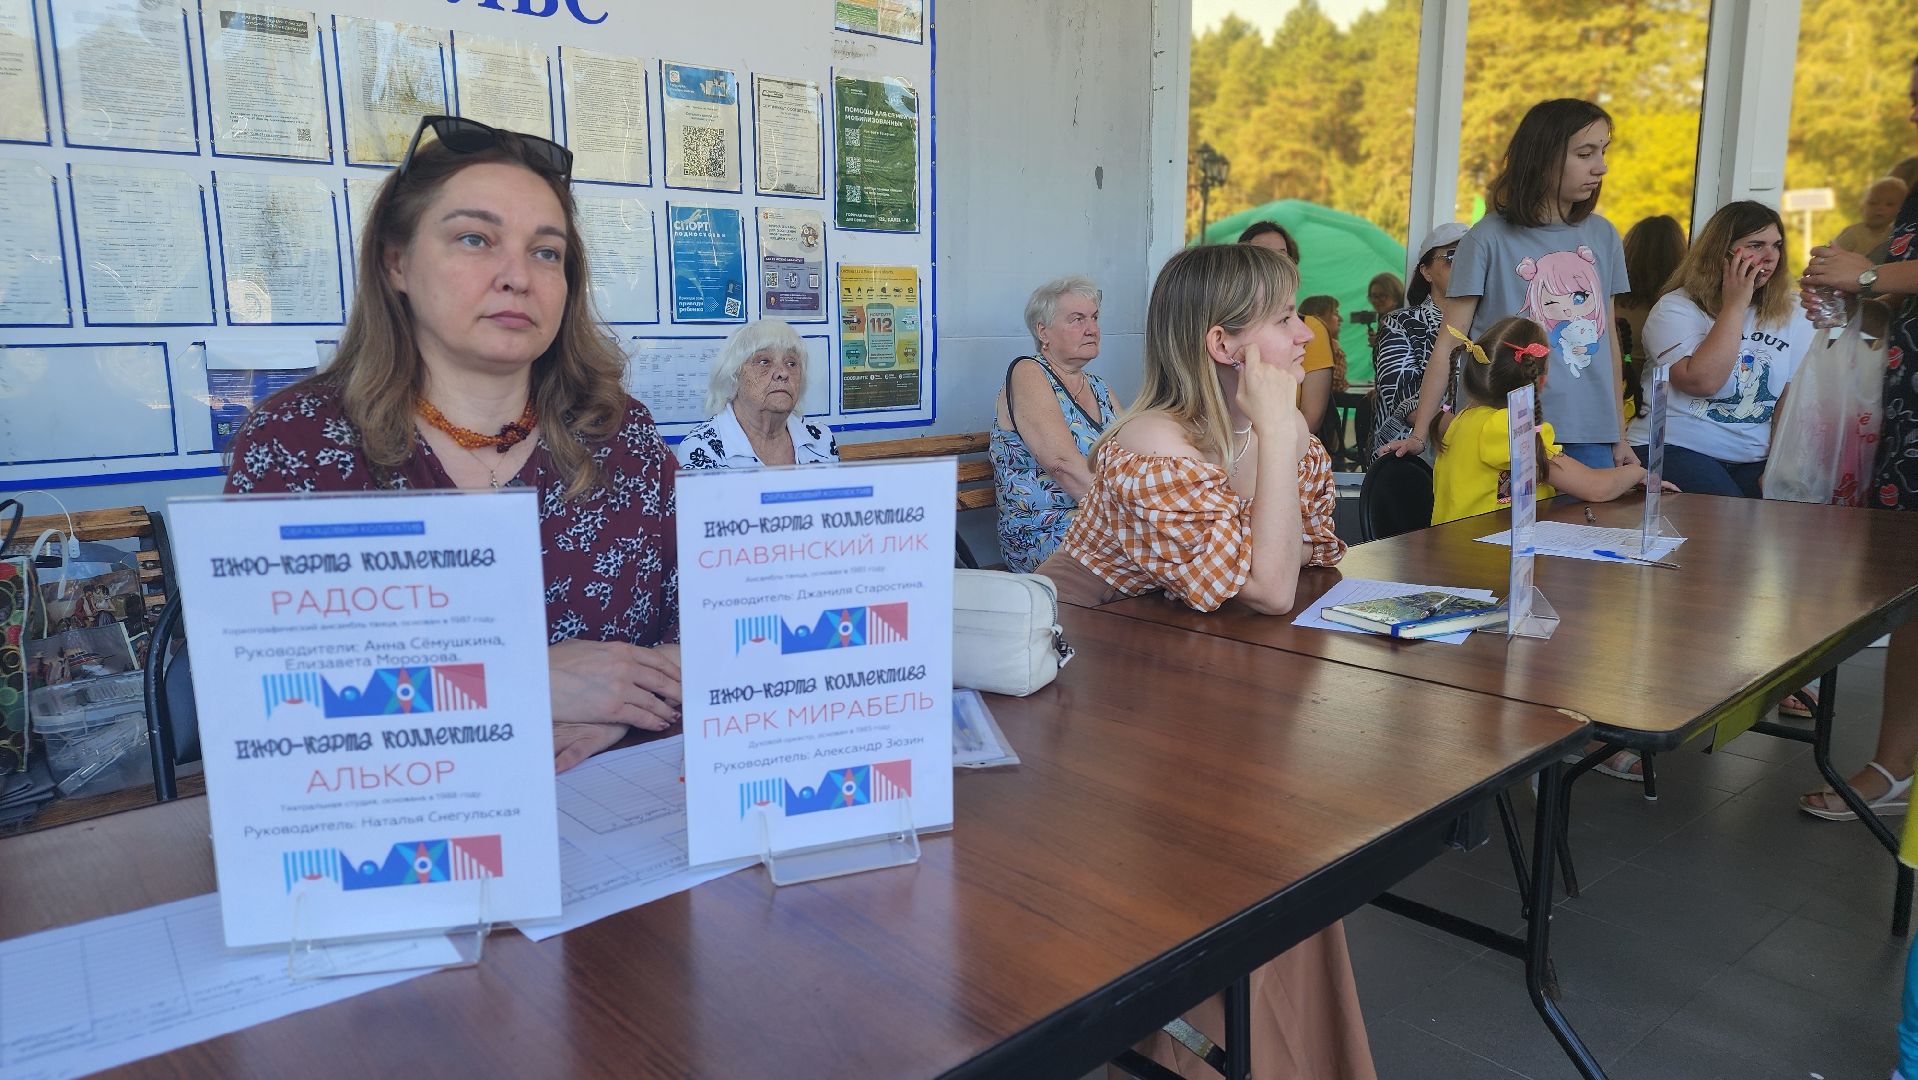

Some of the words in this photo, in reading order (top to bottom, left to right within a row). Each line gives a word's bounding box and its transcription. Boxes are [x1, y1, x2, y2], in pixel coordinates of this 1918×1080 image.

[844, 114, 903, 127] МОБИЛИЗОВАННЫХ
[674, 220, 709, 231] СПОРТ
[869, 317, 893, 334] 112
[1751, 331, 1790, 352] OUT
[697, 533, 874, 569] СЛАВЯНСКИЙ
[880, 533, 929, 554] ЛИК
[270, 584, 449, 618] РАДОСТЬ
[702, 592, 794, 610] Руководитель:
[796, 586, 853, 600] Джамиля
[234, 642, 359, 662] Руководители:
[364, 639, 406, 652] Анна
[410, 635, 506, 651] Сёмушкина,
[285, 656, 372, 671] Елизавета
[703, 709, 779, 739] ПАРК
[788, 691, 935, 728] МИРАБЕЛЬ
[713, 751, 810, 775] Руководитель:
[814, 741, 883, 758] Александр
[885, 735, 925, 748] Зюзин
[306, 760, 456, 794] АЛЬКОР
[243, 820, 356, 840] Руководитель:
[360, 815, 424, 829] Наталья
[428, 807, 521, 823] Снегульская
